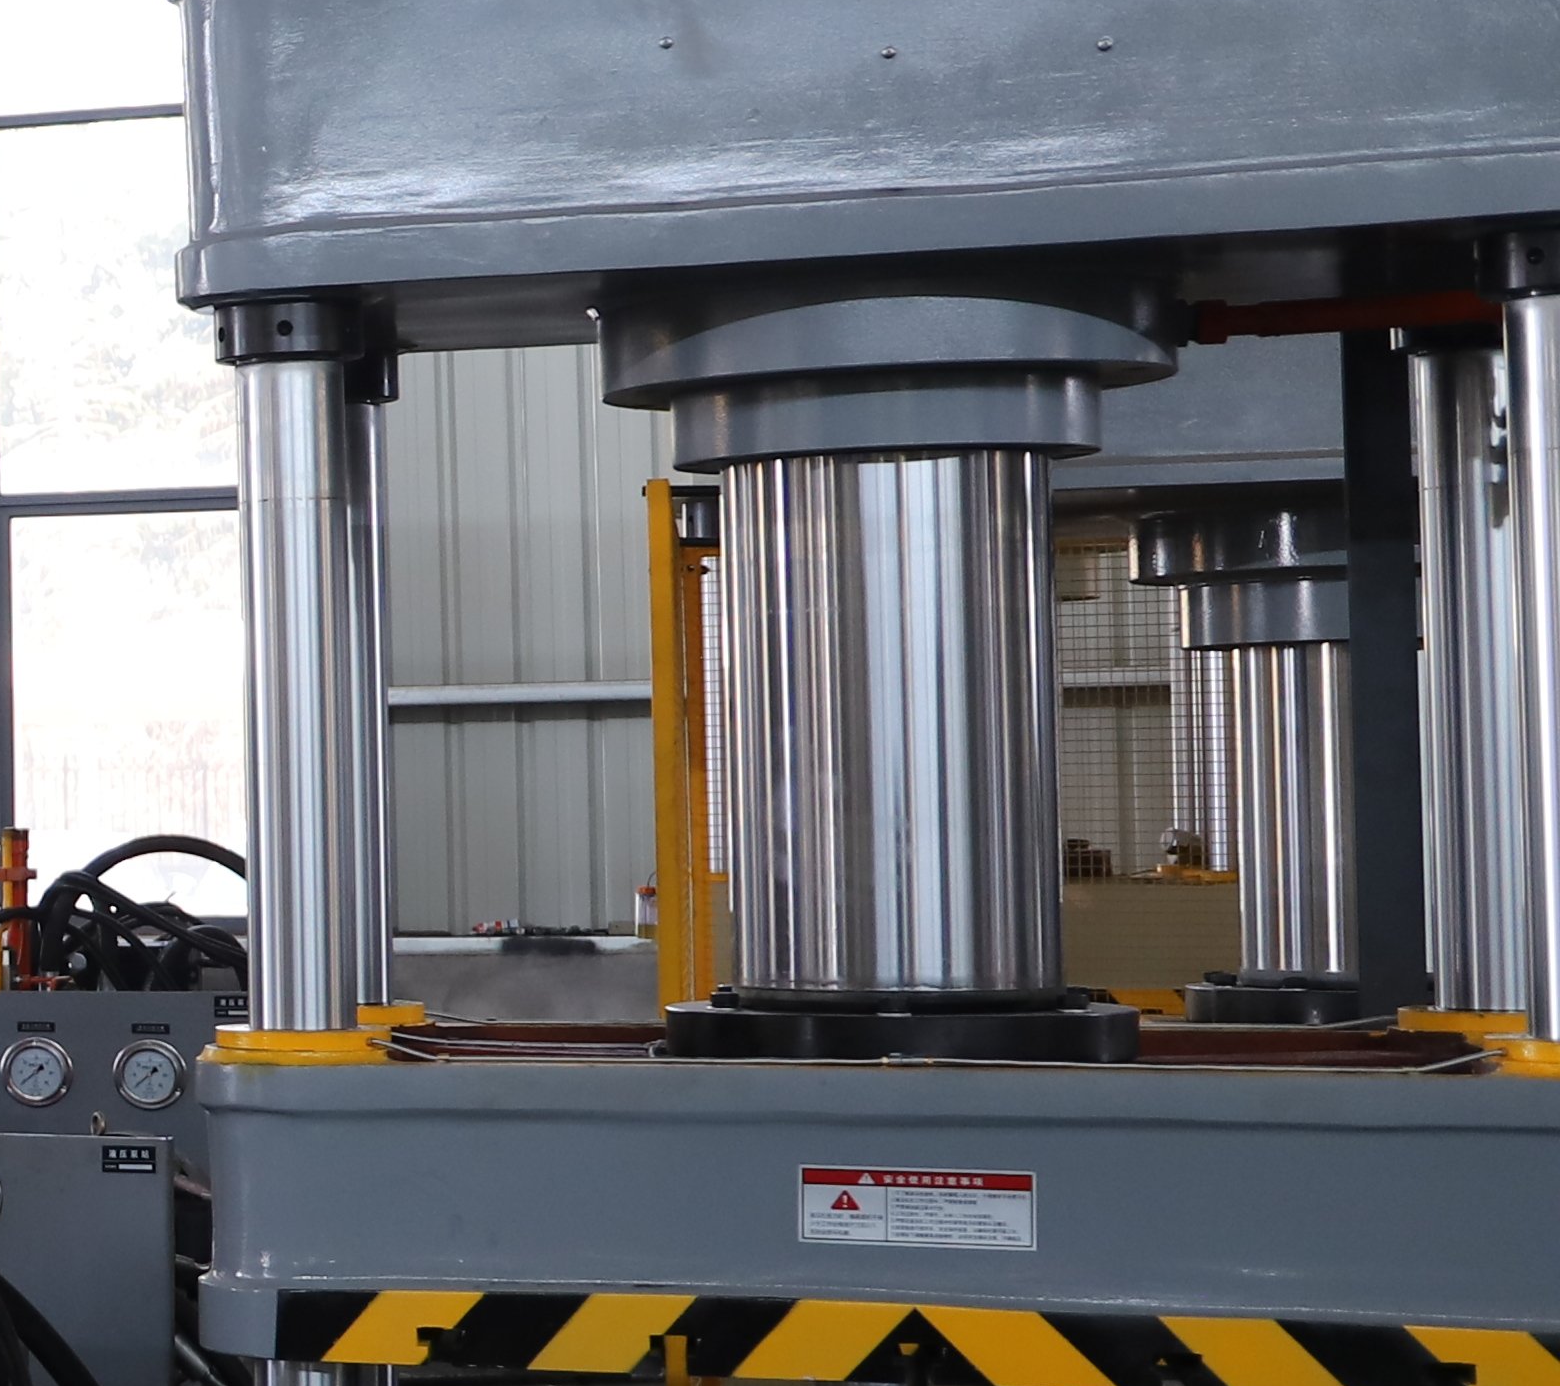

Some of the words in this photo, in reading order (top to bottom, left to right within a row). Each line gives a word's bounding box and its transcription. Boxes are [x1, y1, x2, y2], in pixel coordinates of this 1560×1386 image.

[882, 1174, 985, 1187] 安全使用注意事项
